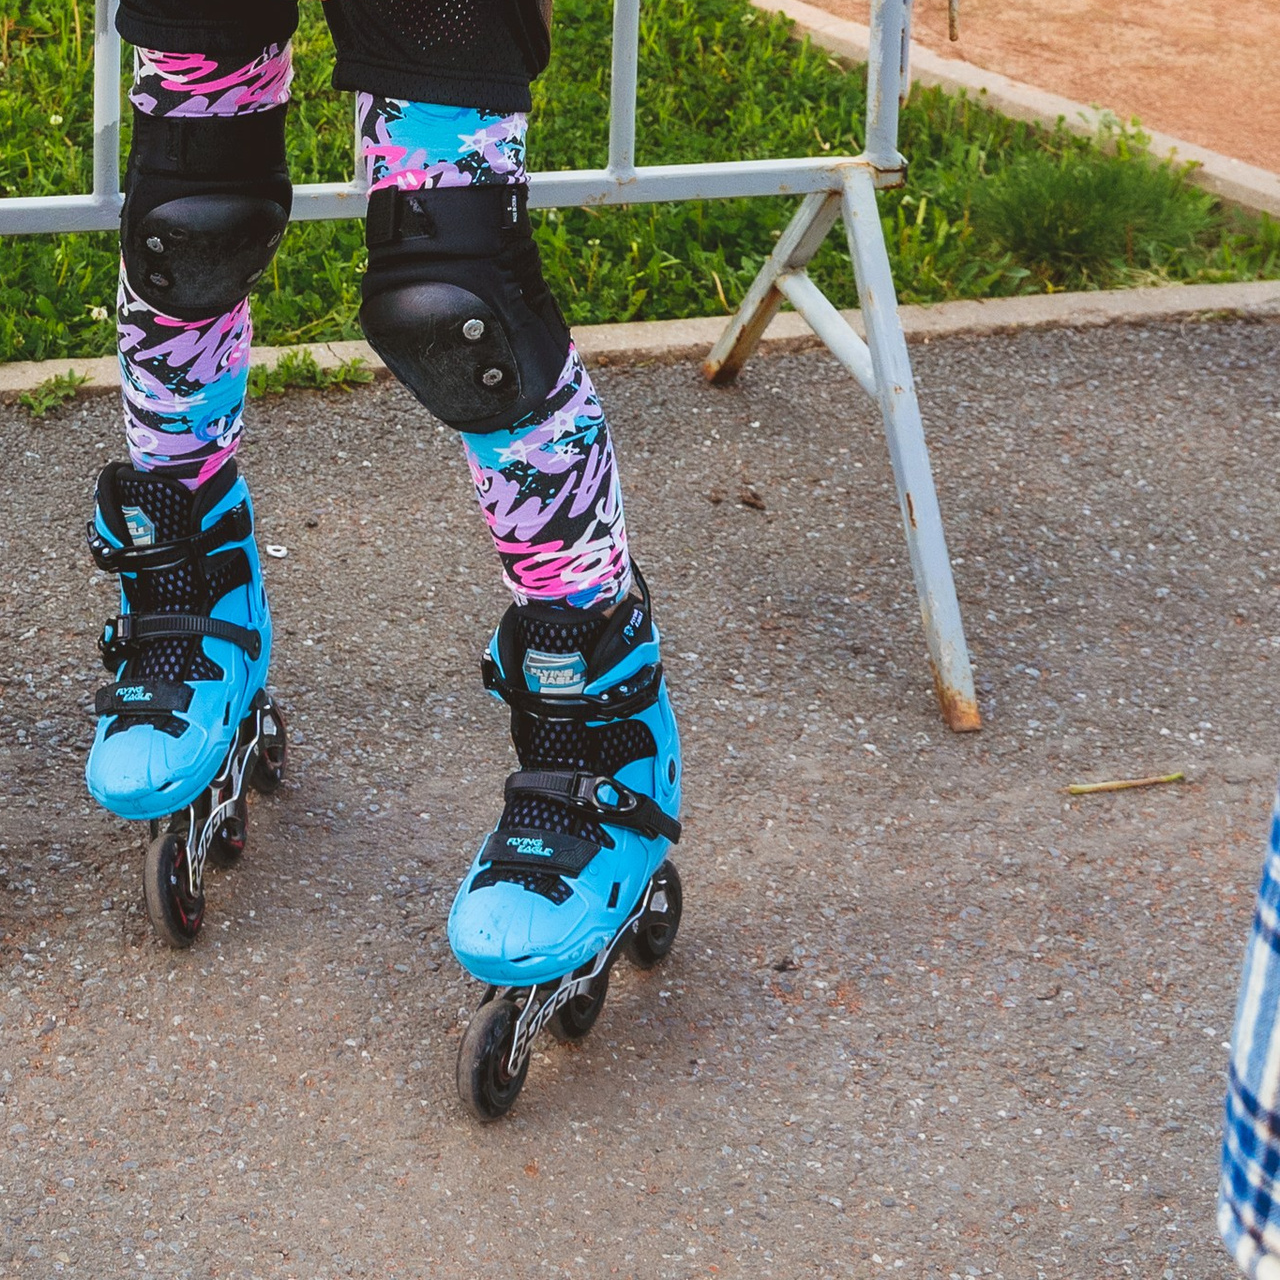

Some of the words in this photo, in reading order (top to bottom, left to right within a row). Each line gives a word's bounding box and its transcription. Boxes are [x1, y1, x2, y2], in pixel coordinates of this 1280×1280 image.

[530, 667, 574, 678] FLYING
[540, 674, 581, 685] EAGLE
[506, 837, 544, 846] FLYING
[516, 844, 554, 857] EAGLE
